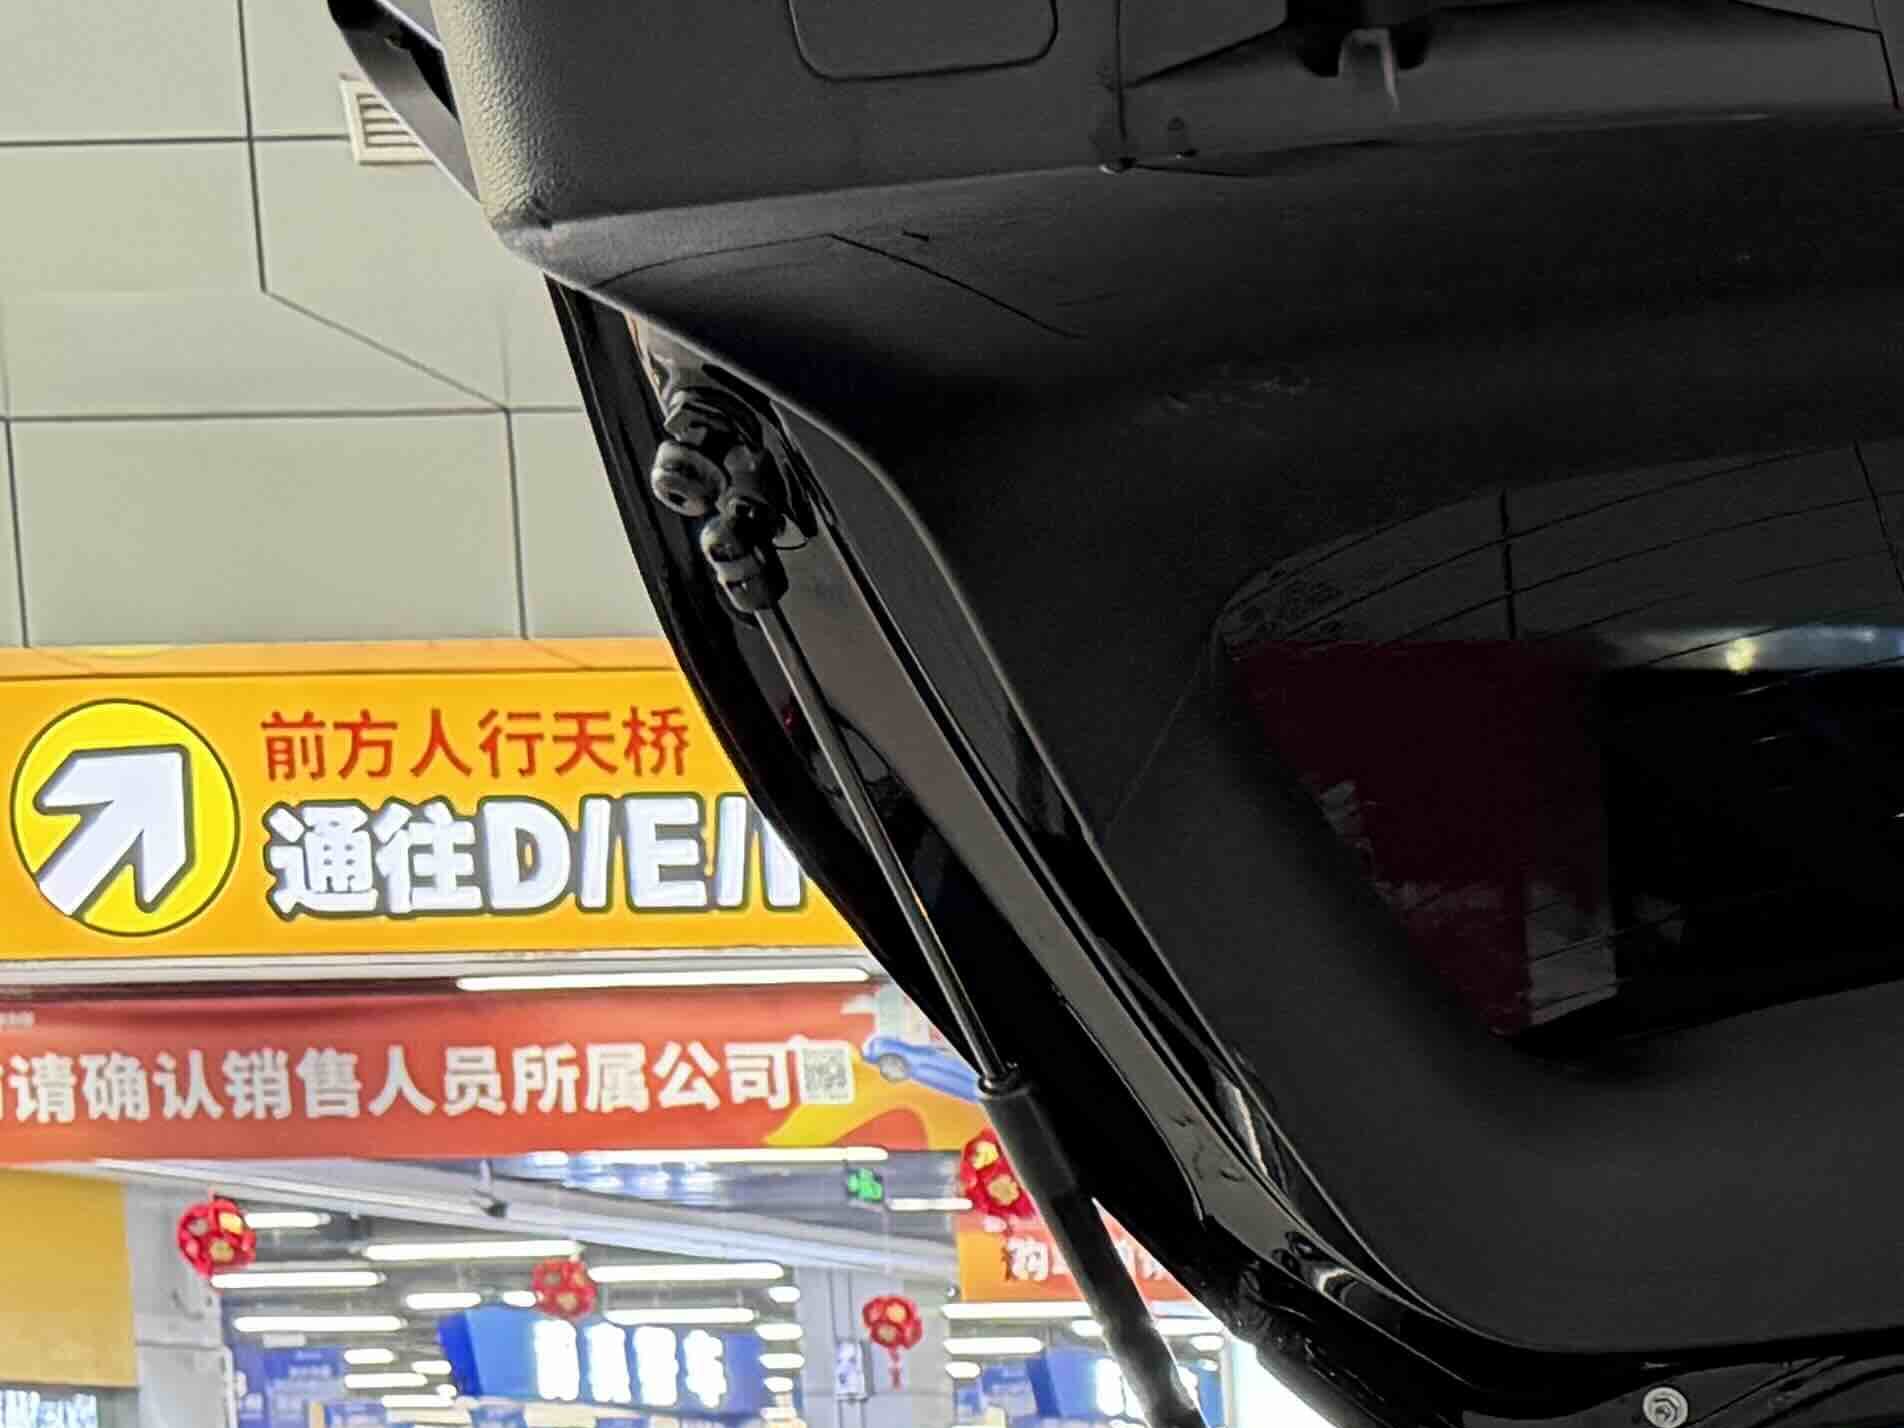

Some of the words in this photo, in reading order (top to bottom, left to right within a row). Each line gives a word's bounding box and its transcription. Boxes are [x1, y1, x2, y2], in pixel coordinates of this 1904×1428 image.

[261, 705, 690, 780] 前方人行天桥
[0, 1041, 786, 1123] 请确认销售人员所属公司
